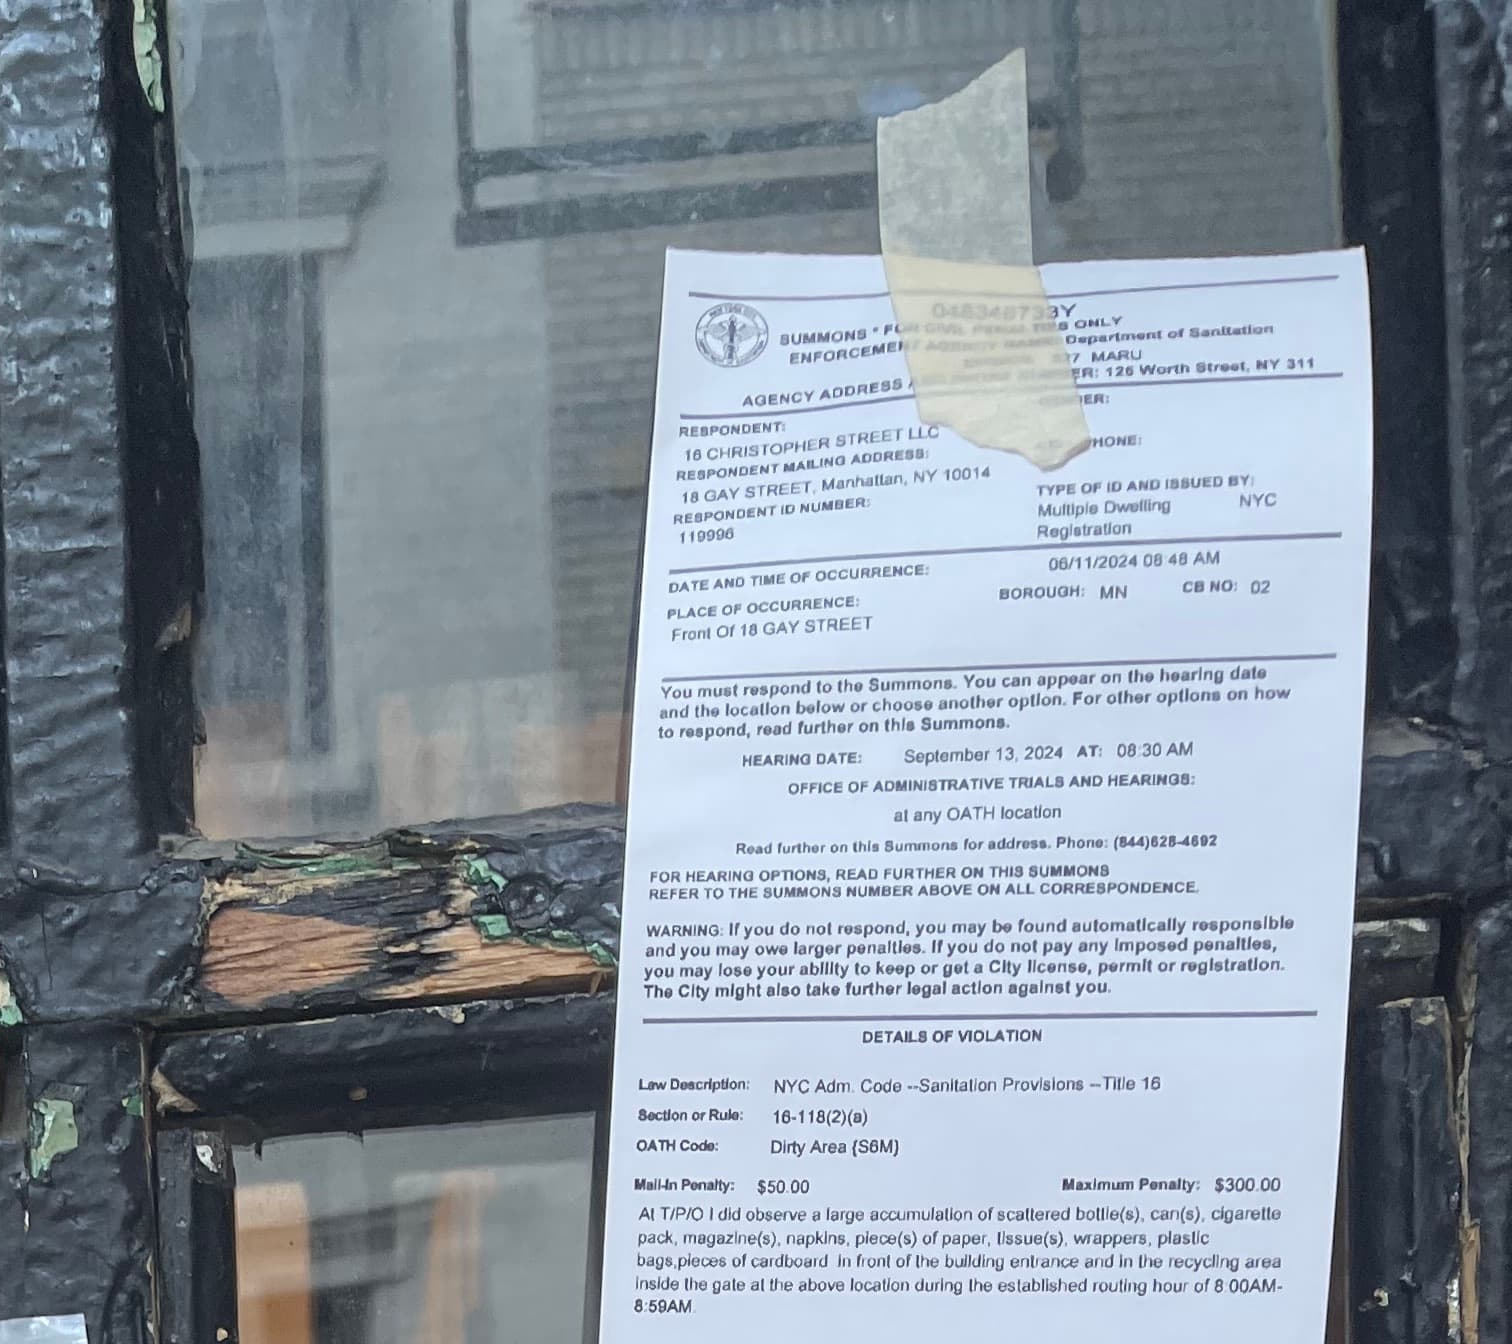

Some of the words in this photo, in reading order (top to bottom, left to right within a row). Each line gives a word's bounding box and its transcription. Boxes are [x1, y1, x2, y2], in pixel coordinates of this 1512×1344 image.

[1091, 349, 1142, 362] MARU
[678, 420, 785, 437] RESPONDENT:
[706, 436, 829, 461] CHRISTOPHER
[835, 427, 903, 447] STREET
[908, 423, 938, 440] LLC
[1037, 501, 1098, 519] Multiple
[1103, 498, 1170, 515] Dwelling
[1239, 492, 1276, 507] NYC
[1037, 521, 1131, 541] Registration
[998, 584, 1084, 600] BOROUGH:
[1099, 584, 1127, 599] MN
[671, 626, 711, 642] Front
[740, 622, 757, 637] 18
[762, 619, 799, 635] GAY
[804, 615, 872, 633] STREET
[903, 747, 990, 767] September
[1023, 745, 1063, 760] 2024
[913, 810, 941, 825] any
[946, 805, 995, 821] OATH
[1000, 804, 1061, 819] location
[862, 1030, 927, 1043] DETAILS
[932, 1029, 953, 1043] OF
[957, 1028, 1042, 1043] VIOLATION
[1061, 1177, 1134, 1191] Maximum
[1138, 1177, 1199, 1193] Penalty:
